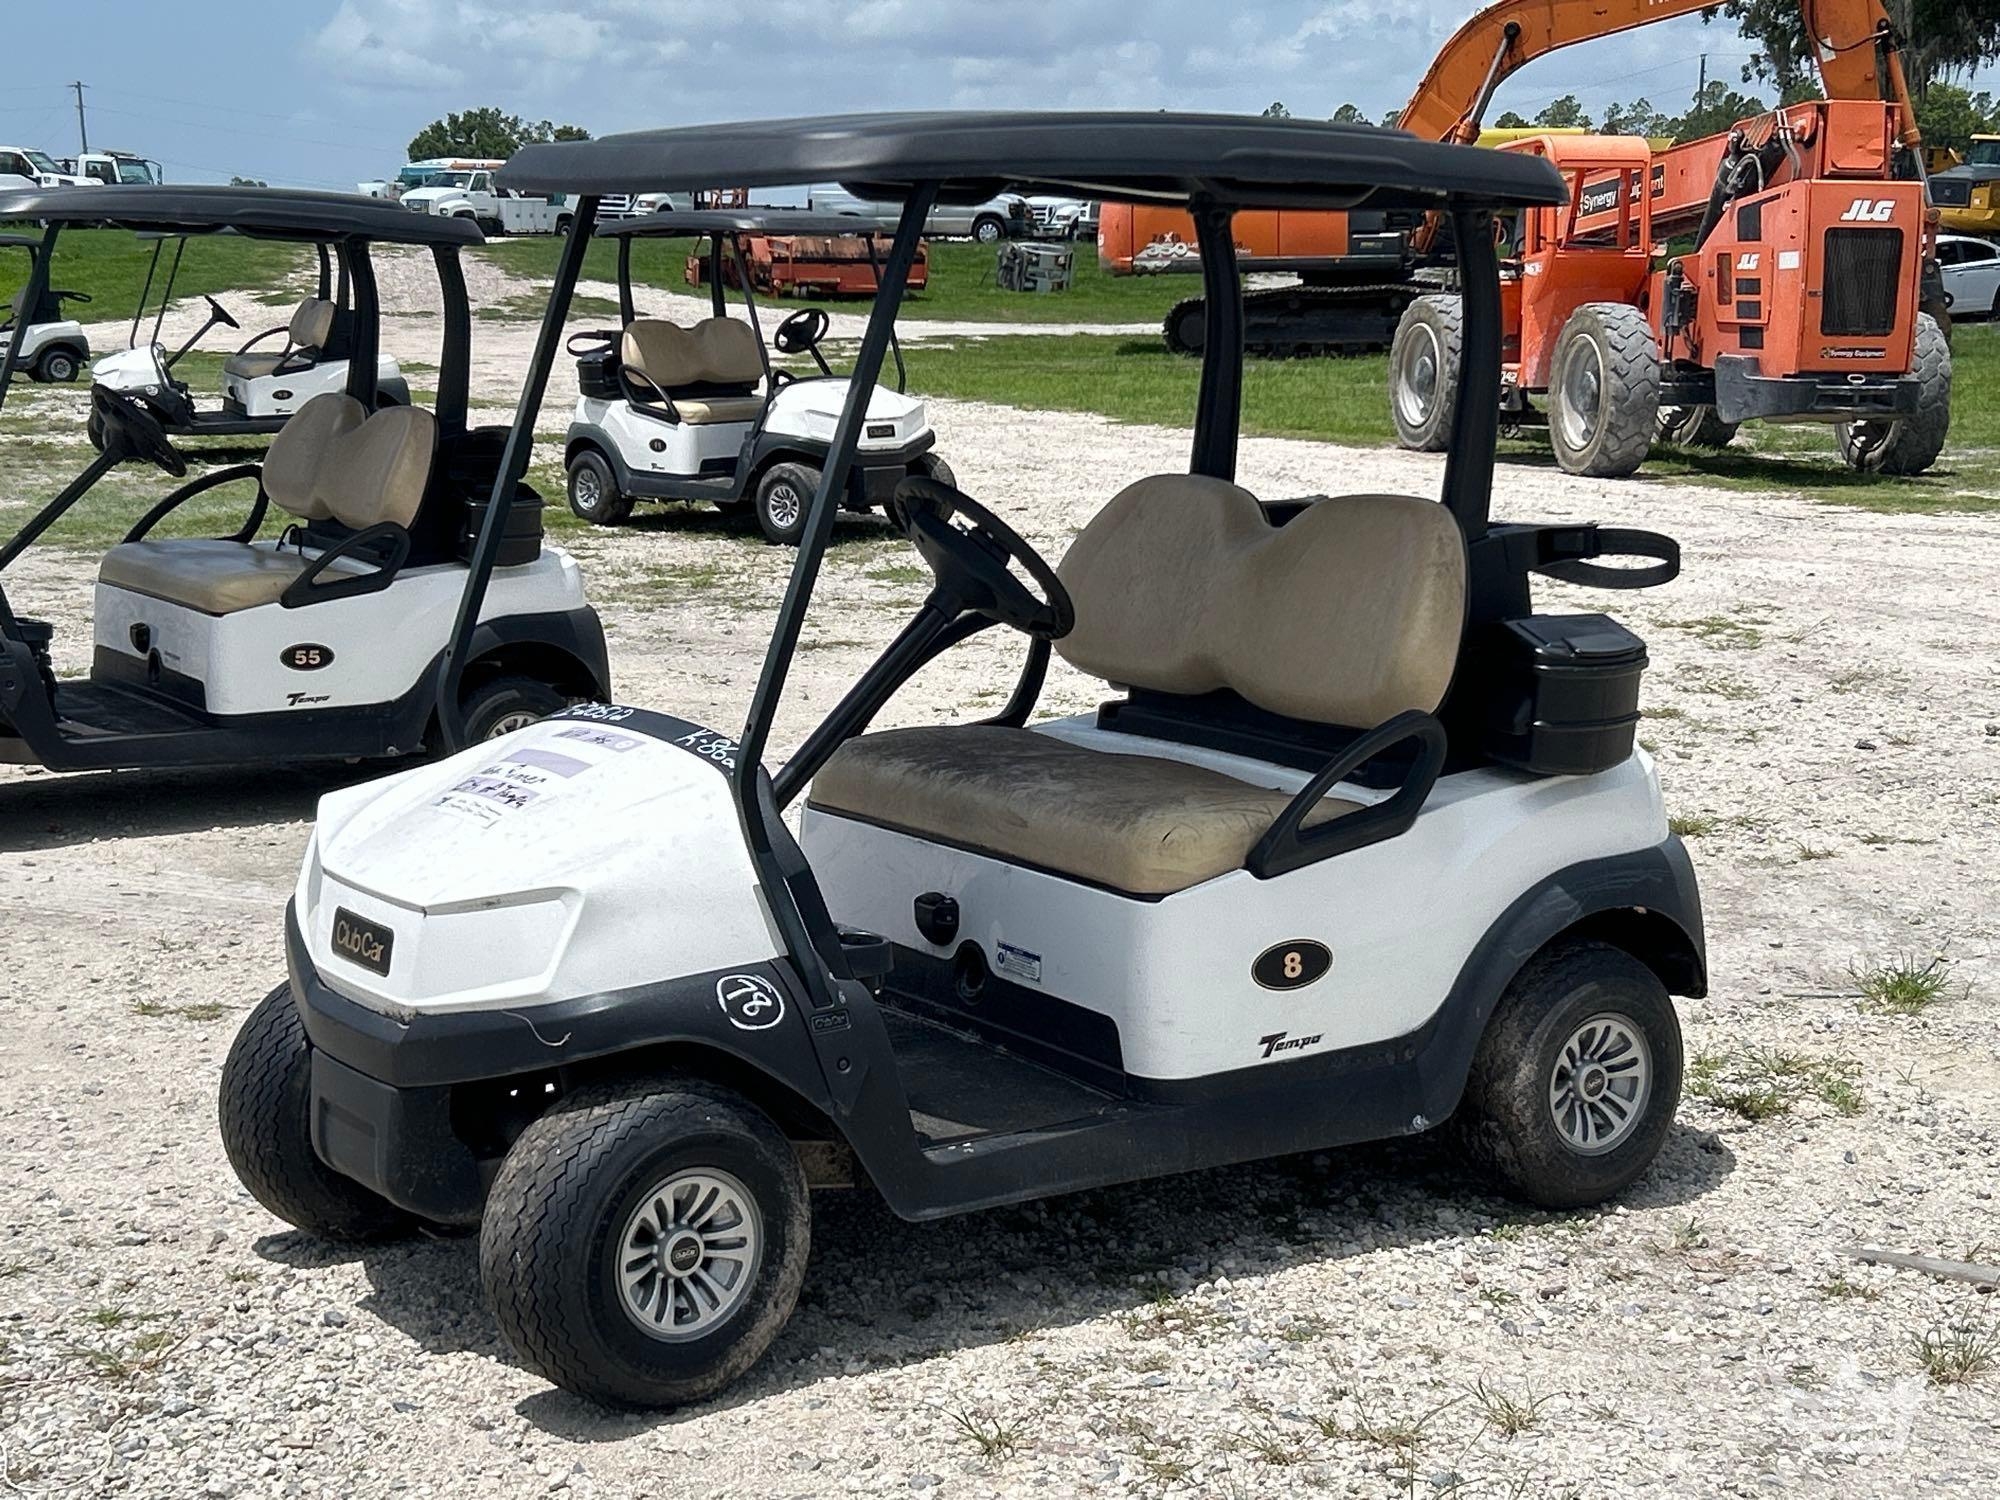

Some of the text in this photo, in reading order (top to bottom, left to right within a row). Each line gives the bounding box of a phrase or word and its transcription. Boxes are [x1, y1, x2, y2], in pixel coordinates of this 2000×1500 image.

[1583, 189, 1617, 212] Synergy
[1840, 200, 1896, 221] JLG
[1736, 253, 1760, 269] JLG
[294, 649, 321, 665] 55
[286, 692, 331, 706] Tempo
[1284, 951, 1303, 979] 8
[726, 978, 773, 1017] 78
[1258, 1031, 1326, 1059] Tempo
